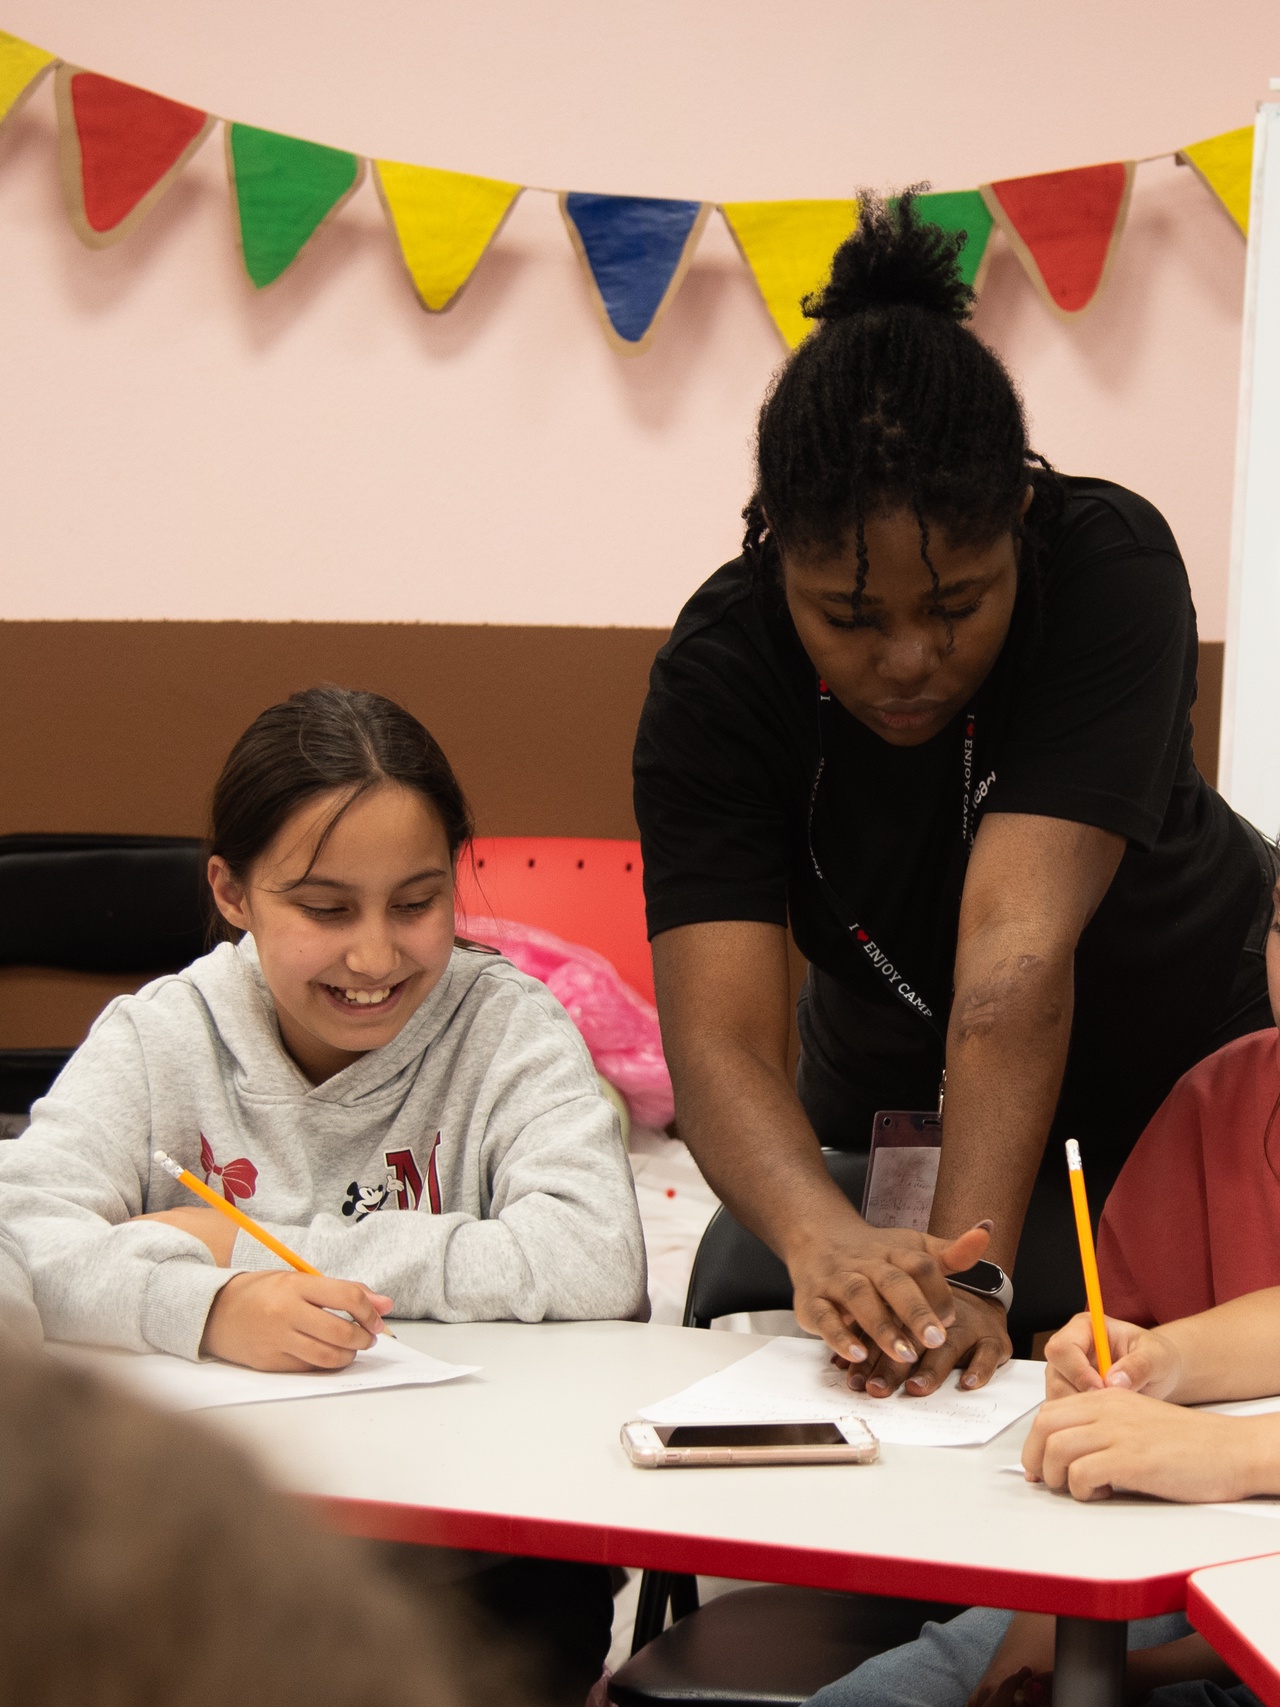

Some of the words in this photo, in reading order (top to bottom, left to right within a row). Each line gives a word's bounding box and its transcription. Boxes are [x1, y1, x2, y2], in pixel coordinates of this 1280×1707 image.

[963, 739, 973, 790] ENJOY
[962, 794, 970, 840] CAMP
[848, 923, 859, 931] I
[863, 941, 902, 983] ENJOY
[898, 982, 933, 1018] CAMP
